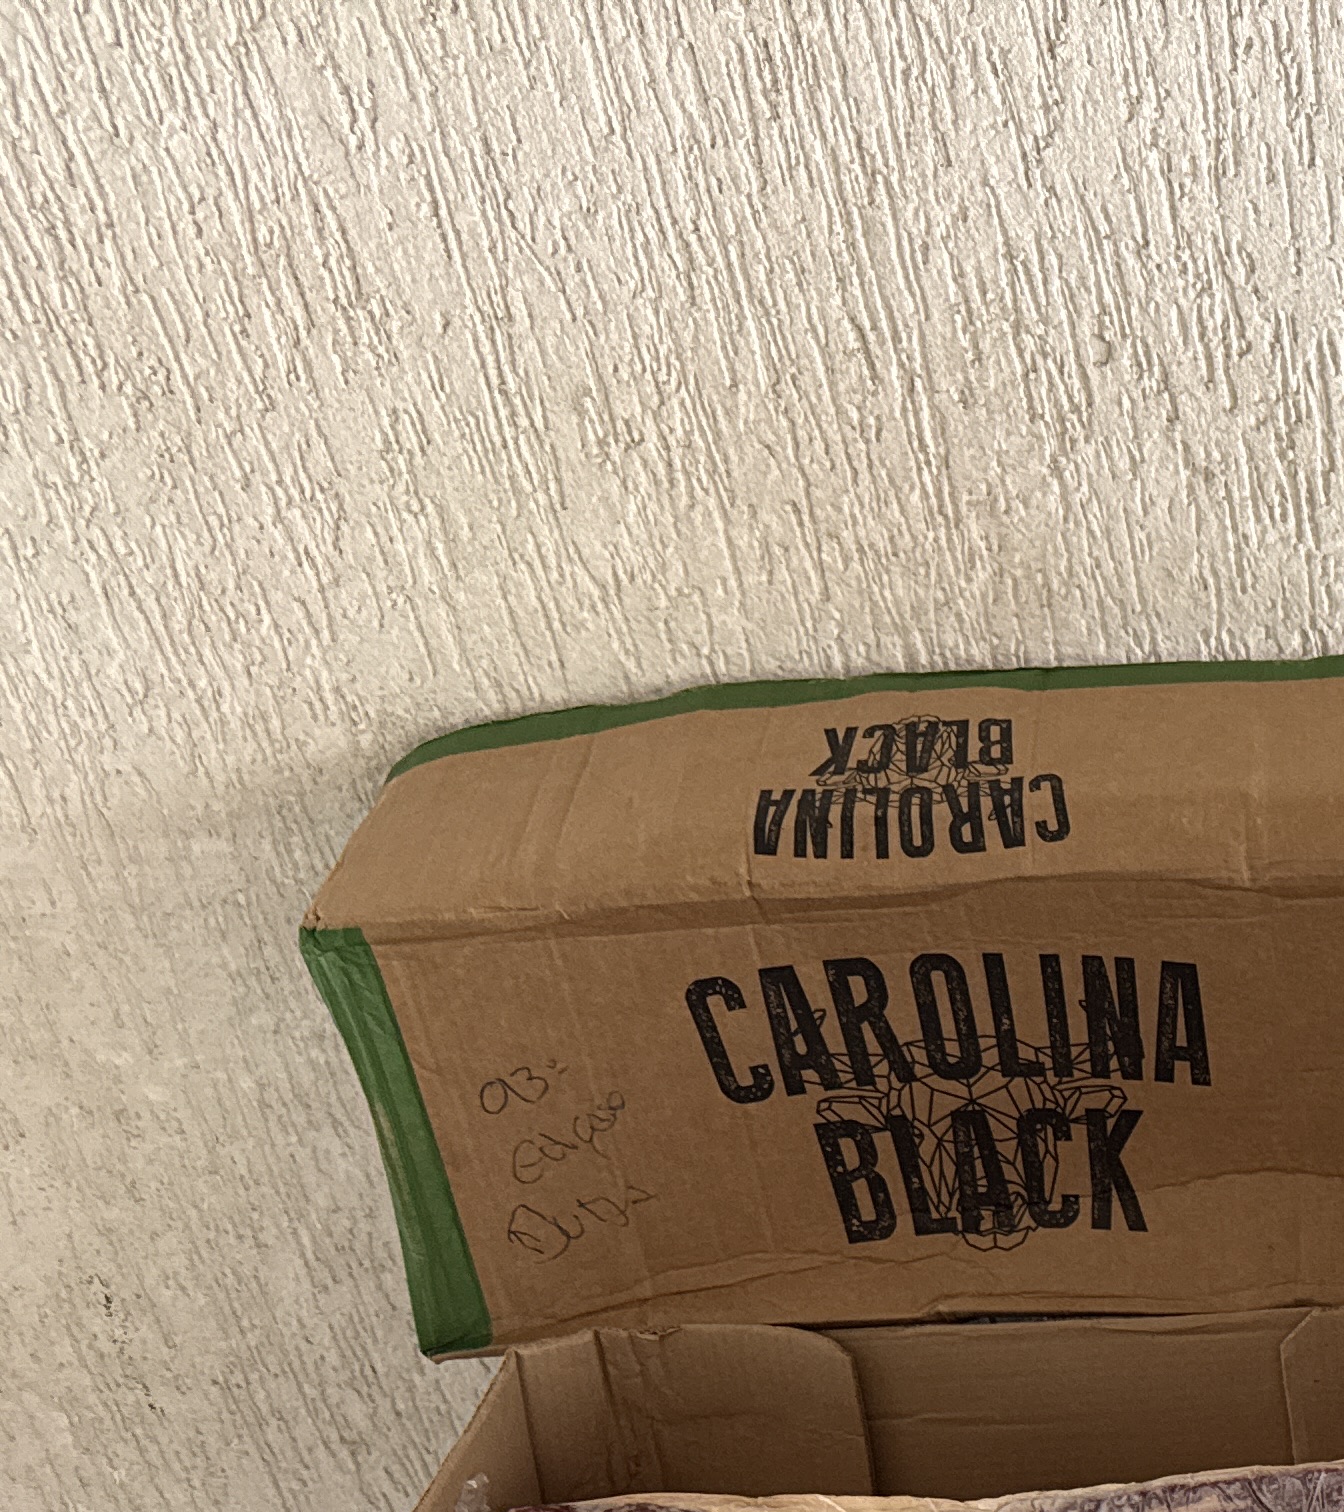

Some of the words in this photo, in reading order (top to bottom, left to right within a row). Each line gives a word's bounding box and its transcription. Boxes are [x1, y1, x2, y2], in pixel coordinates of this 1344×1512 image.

[808, 718, 1014, 777] BLACK
[753, 773, 1071, 860] CAROLINA
[685, 952, 1212, 1104] CAROLINA
[813, 1107, 1148, 1245] BLACK
